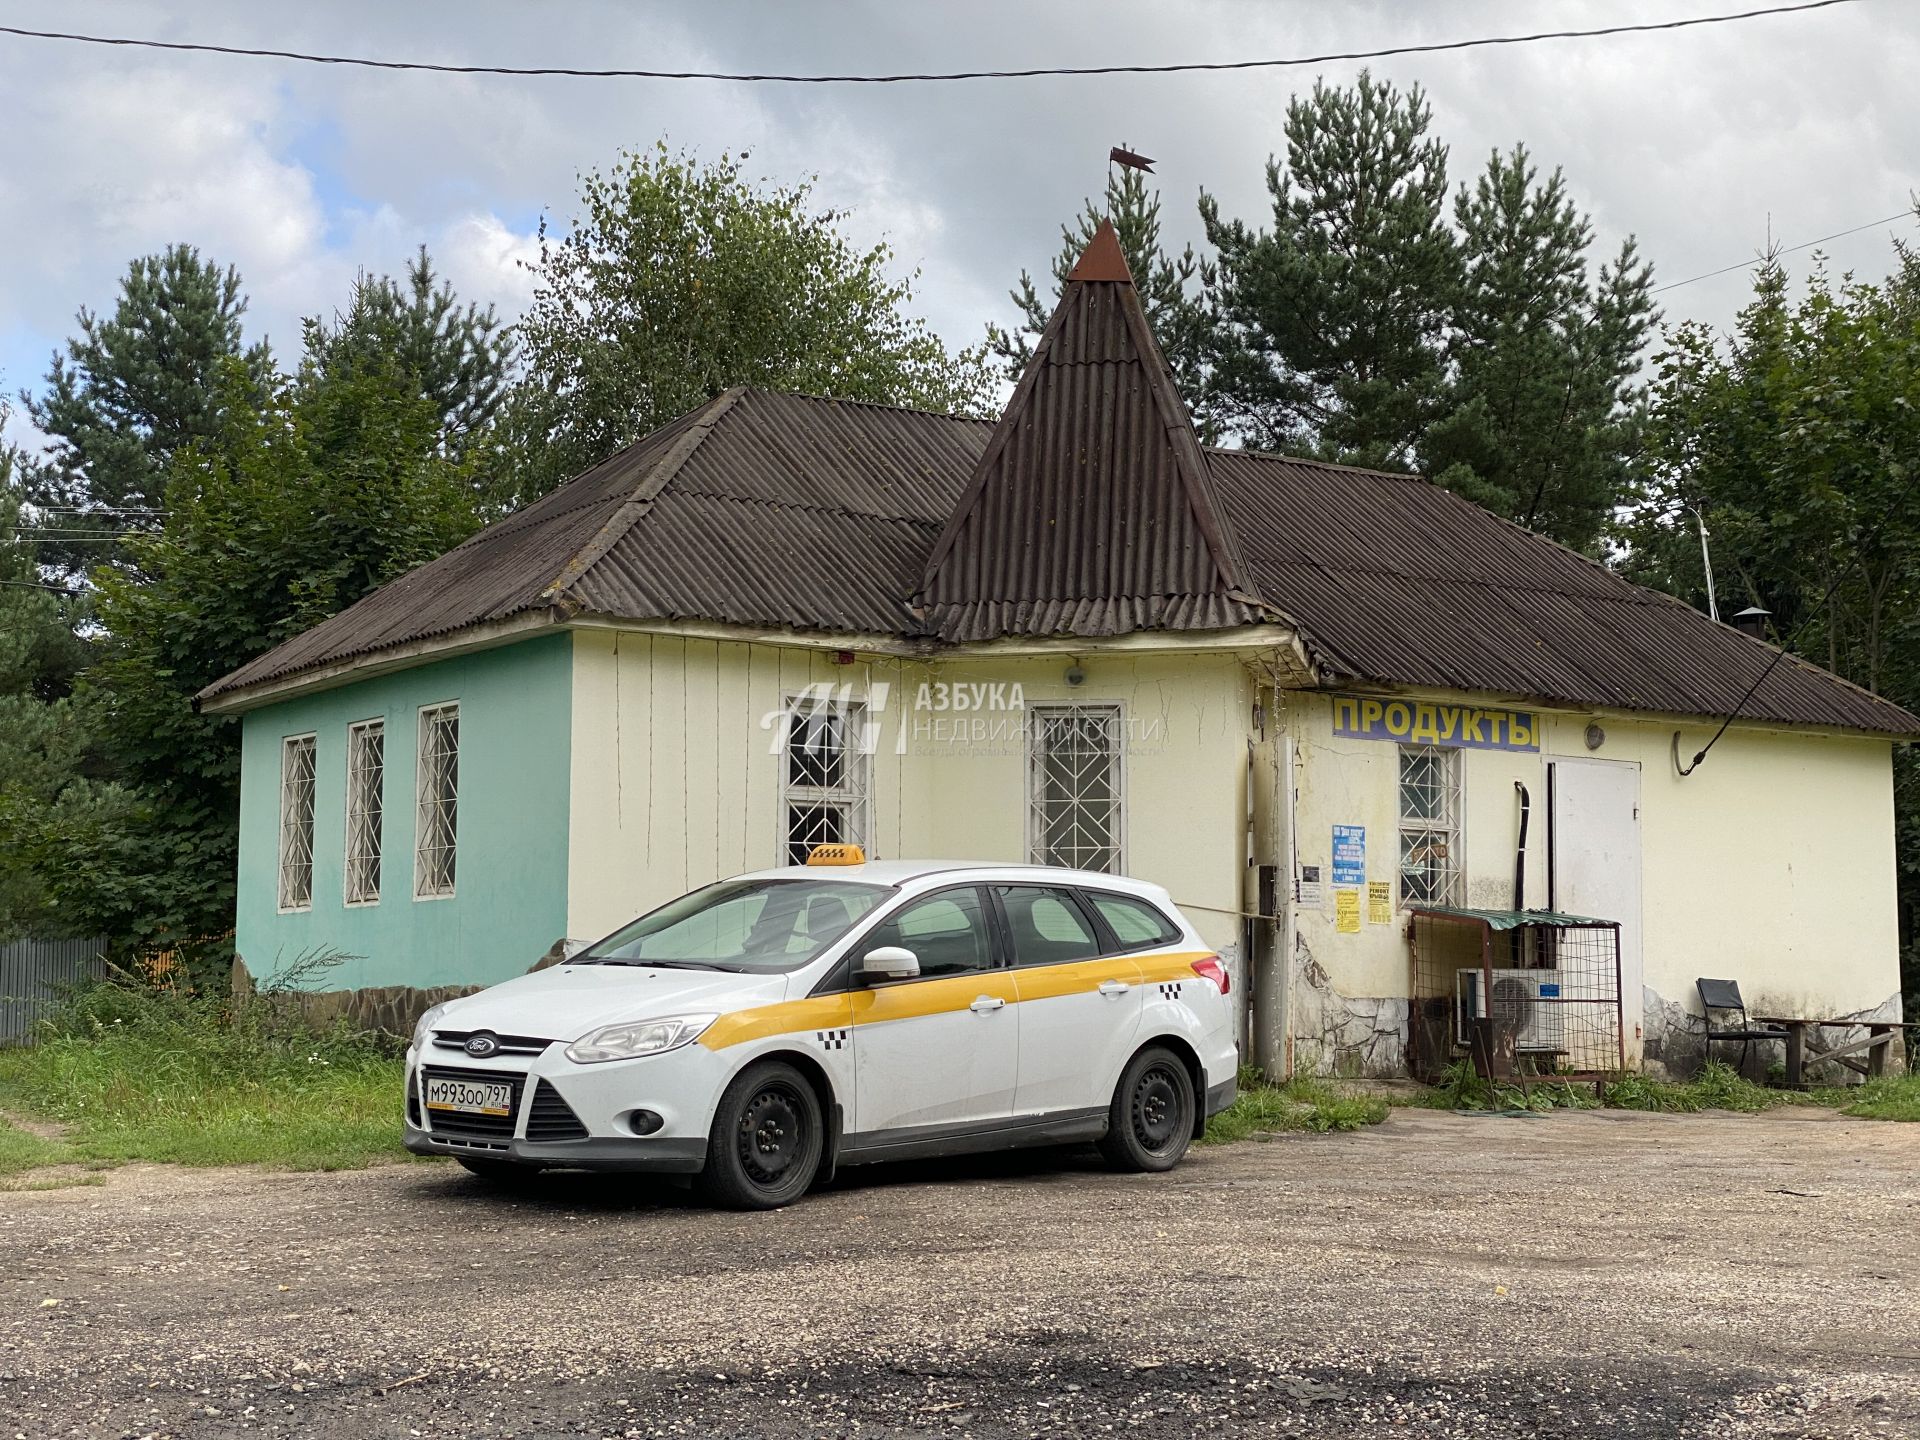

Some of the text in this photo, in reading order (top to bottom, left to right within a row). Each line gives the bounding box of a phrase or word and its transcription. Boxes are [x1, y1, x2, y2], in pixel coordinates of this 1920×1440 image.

[1334, 697, 1540, 747] ПРОДУКТЫ
[470, 1040, 487, 1051] Ford
[486, 1085, 508, 1102] 797
